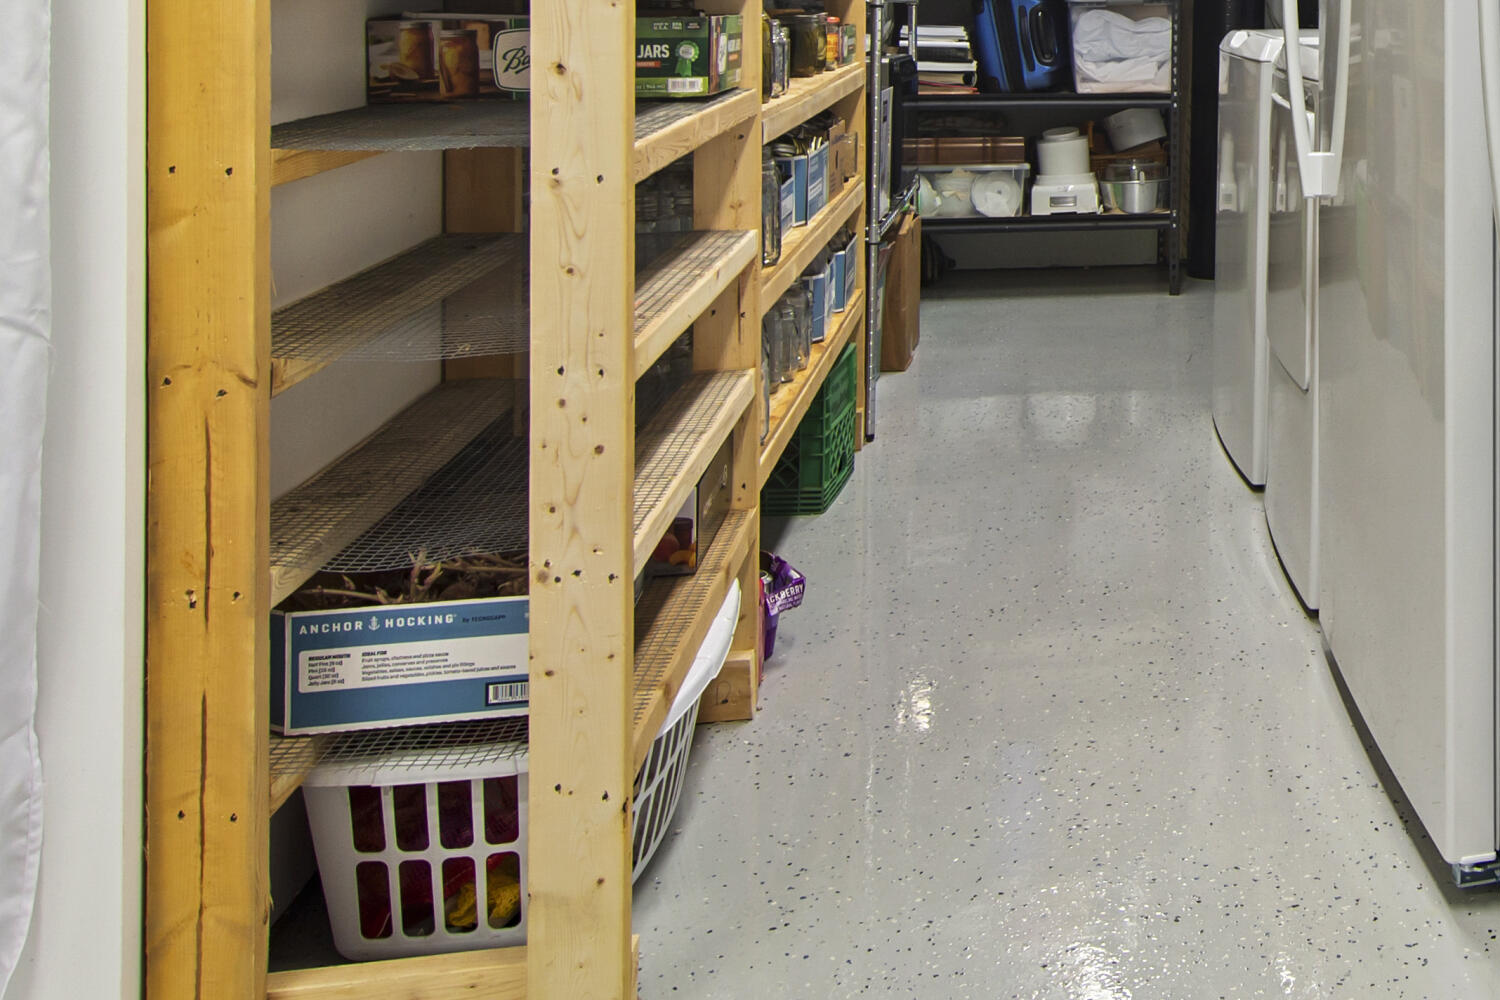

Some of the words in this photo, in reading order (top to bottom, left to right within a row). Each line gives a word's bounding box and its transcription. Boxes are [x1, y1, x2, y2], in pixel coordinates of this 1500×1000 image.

[637, 44, 670, 58] JARS
[299, 620, 364, 635] ANCHOR
[384, 613, 455, 629] HOCKING
